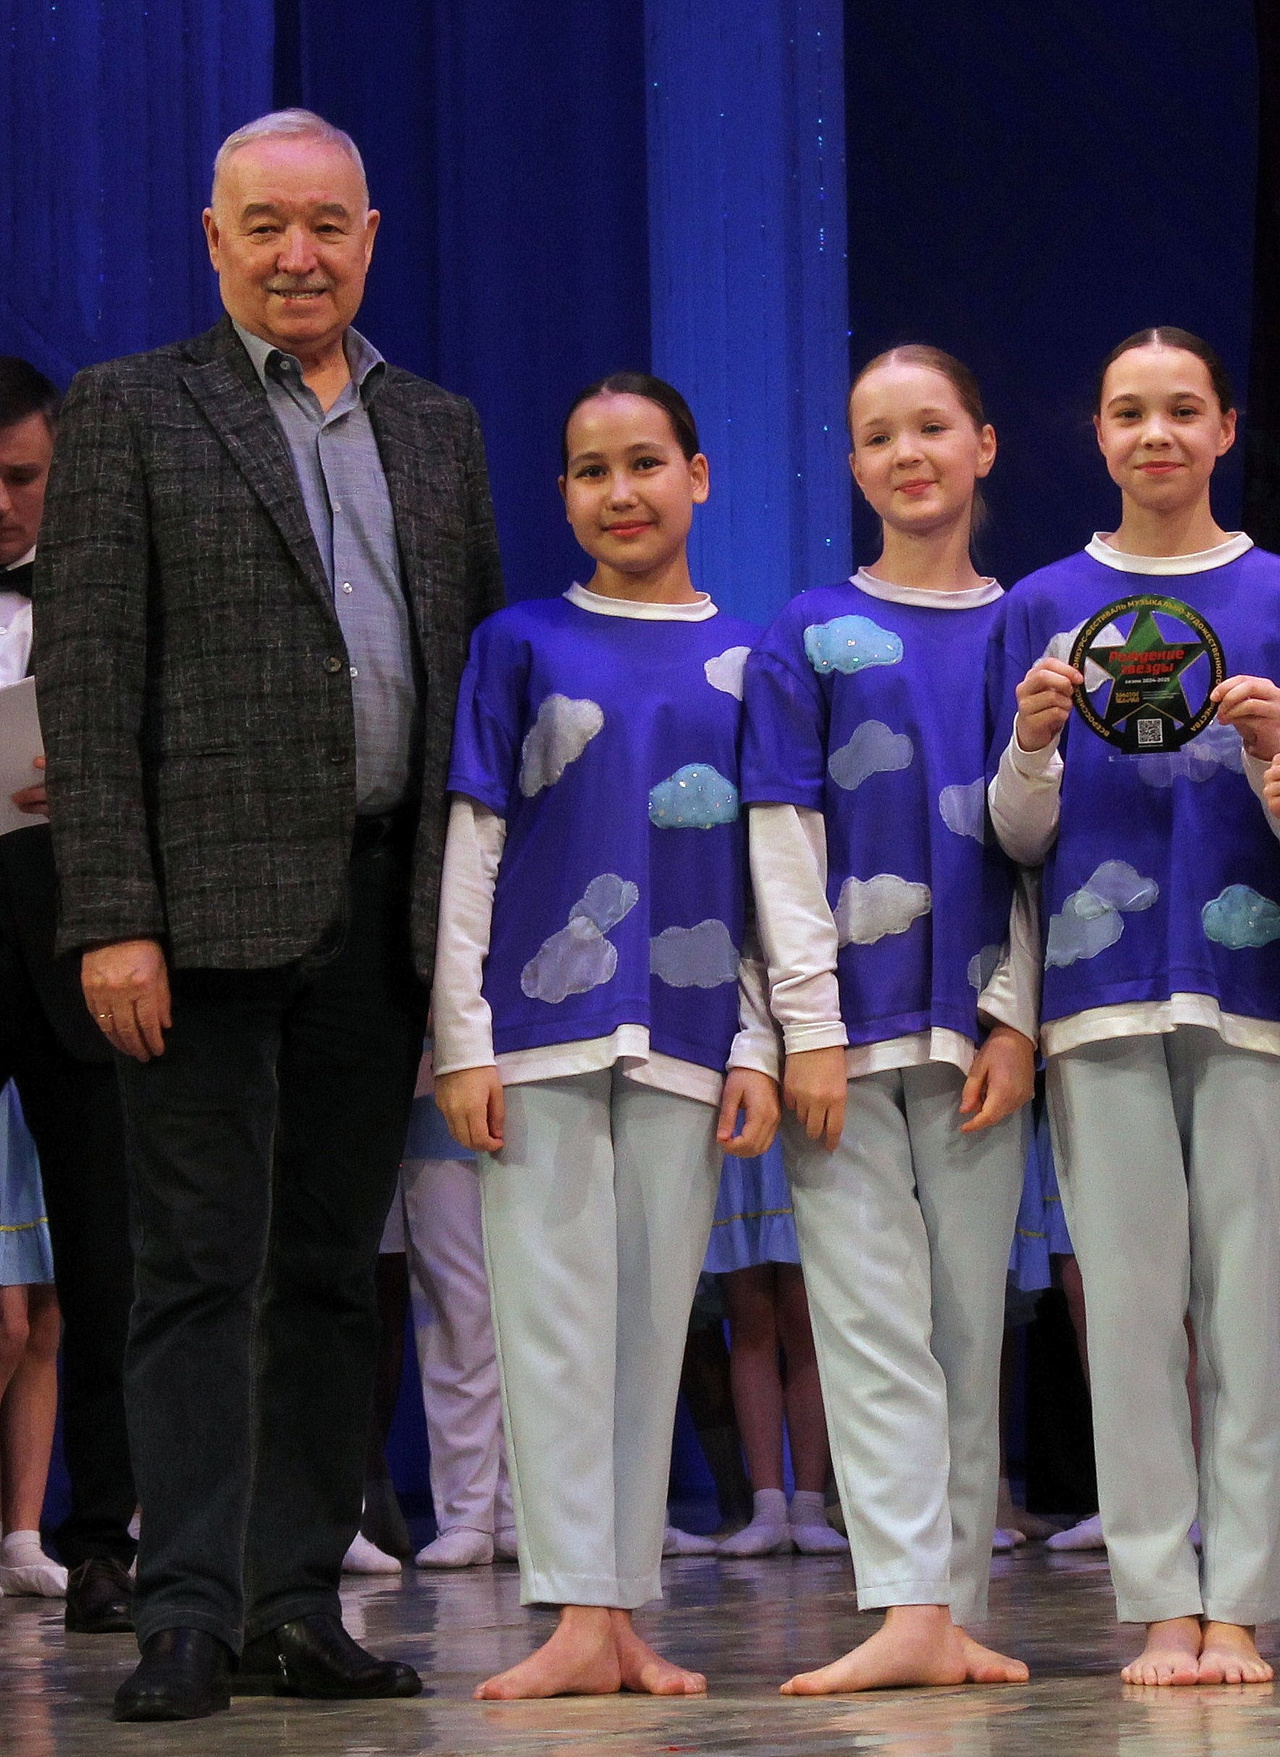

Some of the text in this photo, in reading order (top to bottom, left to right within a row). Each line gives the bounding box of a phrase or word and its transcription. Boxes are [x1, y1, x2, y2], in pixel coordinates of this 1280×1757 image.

[1072, 604, 1127, 669] ОНКУРС-ФЕСТИВАЛЬ
[1109, 650, 1185, 663] Рождение
[1074, 688, 1110, 737] ВСЕРОССИЙС
